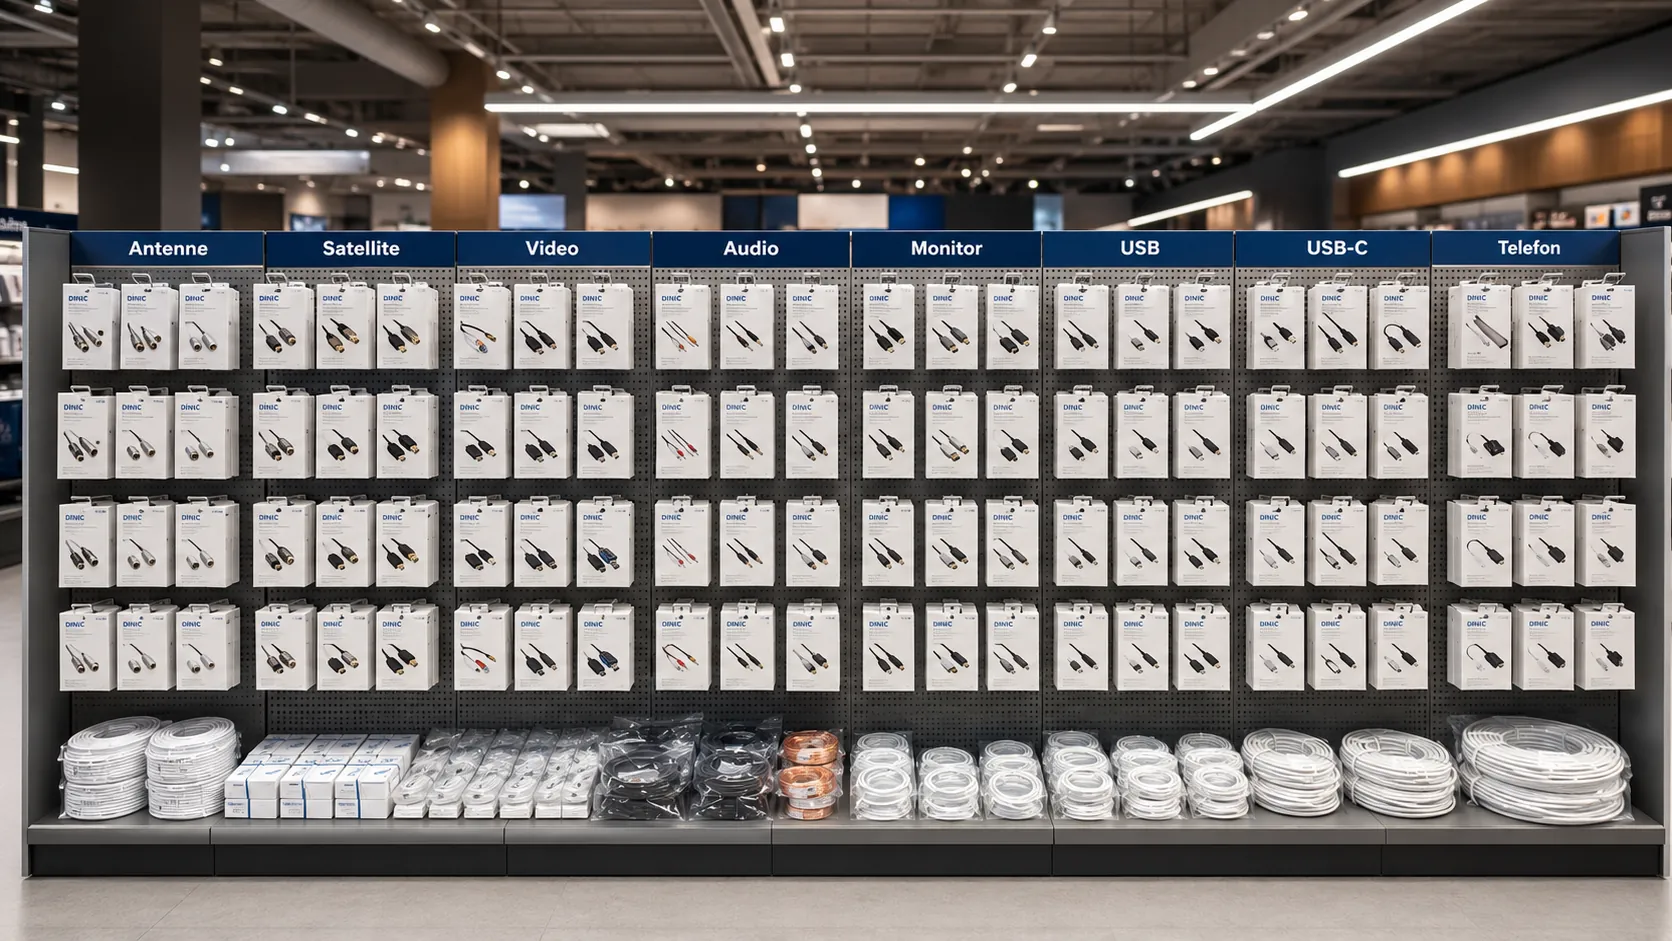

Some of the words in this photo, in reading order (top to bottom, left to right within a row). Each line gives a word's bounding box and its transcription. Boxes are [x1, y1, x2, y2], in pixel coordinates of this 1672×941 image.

[129, 241, 208, 255] Antenne
[323, 240, 400, 255] Satellite
[526, 240, 579, 255] Video
[723, 240, 779, 255] Audio
[911, 240, 983, 255] Monitor
[1120, 240, 1160, 255] USB
[1307, 240, 1368, 255] USB-C
[1497, 240, 1561, 255] Telefon
